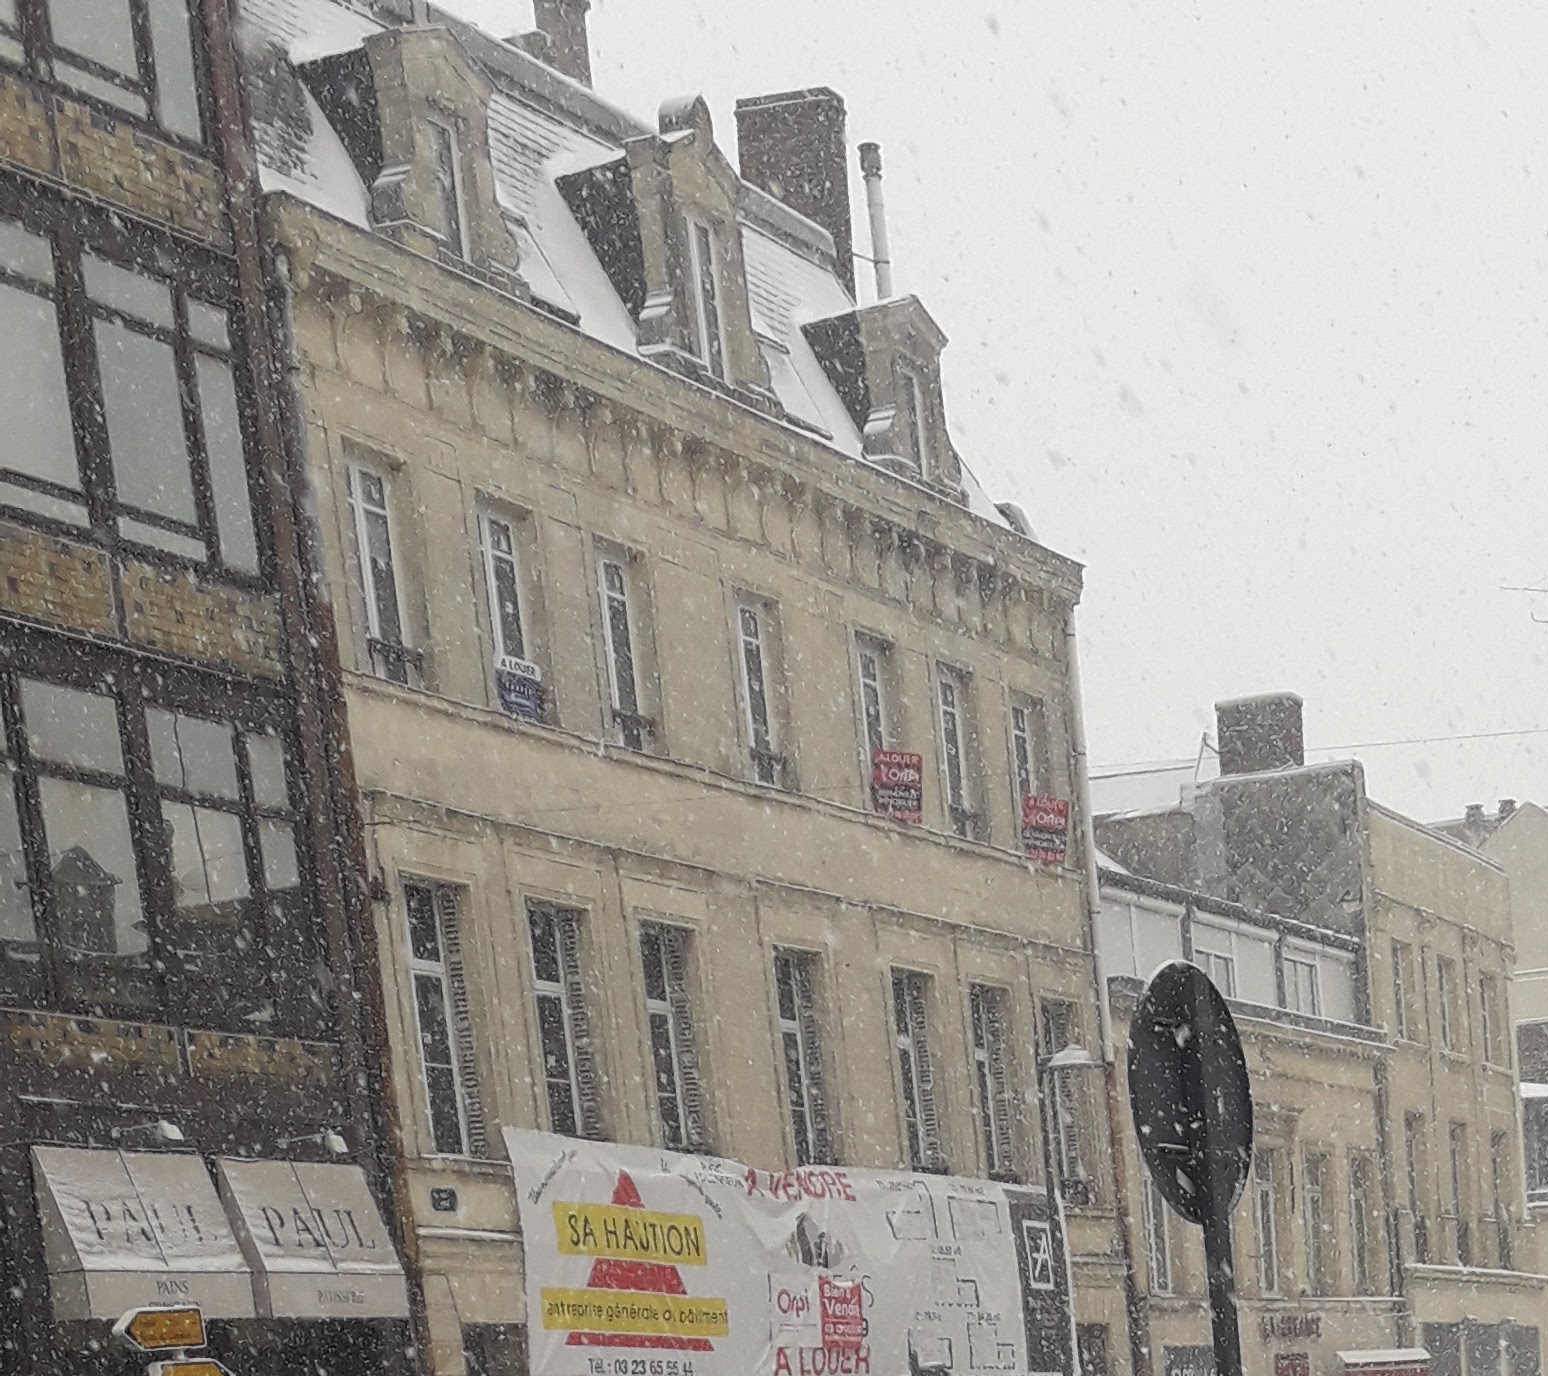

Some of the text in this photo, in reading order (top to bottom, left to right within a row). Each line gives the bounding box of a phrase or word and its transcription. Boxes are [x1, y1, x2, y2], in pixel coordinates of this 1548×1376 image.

[745, 1167, 765, 1197] A
[768, 1167, 857, 1202] VENDRE
[259, 1205, 377, 1251] PAUL
[567, 1213, 701, 1257] SA HAUTION
[776, 1287, 811, 1318] Orpi
[614, 1358, 628, 1376] 03
[630, 1359, 647, 1376] 23
[649, 1359, 664, 1376] 65
[666, 1361, 679, 1376] 55
[773, 1342, 871, 1376] A LOUER
